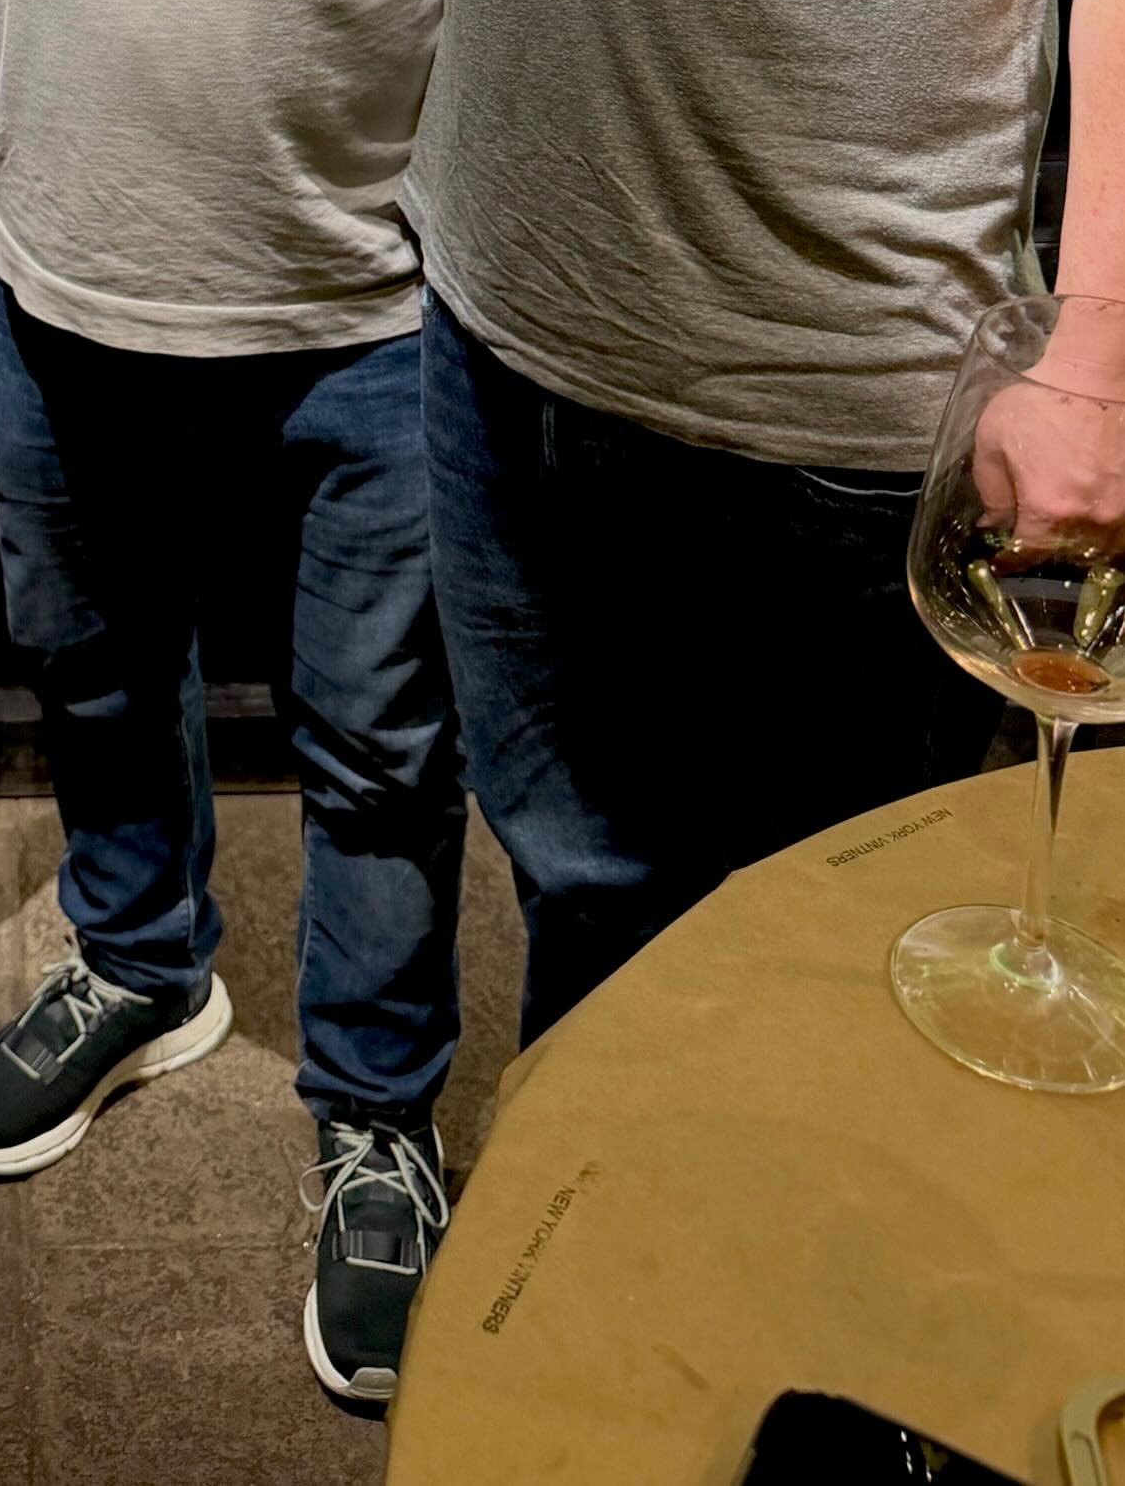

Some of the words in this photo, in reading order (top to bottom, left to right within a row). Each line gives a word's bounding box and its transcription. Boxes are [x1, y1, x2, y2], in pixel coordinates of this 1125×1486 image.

[887, 820, 925, 843] YORK
[922, 807, 953, 829] NEW
[826, 835, 889, 867] VINTNERS
[547, 1185, 576, 1219] NEW
[523, 1219, 557, 1261] YORK
[482, 1263, 535, 1334] VINTNERS
